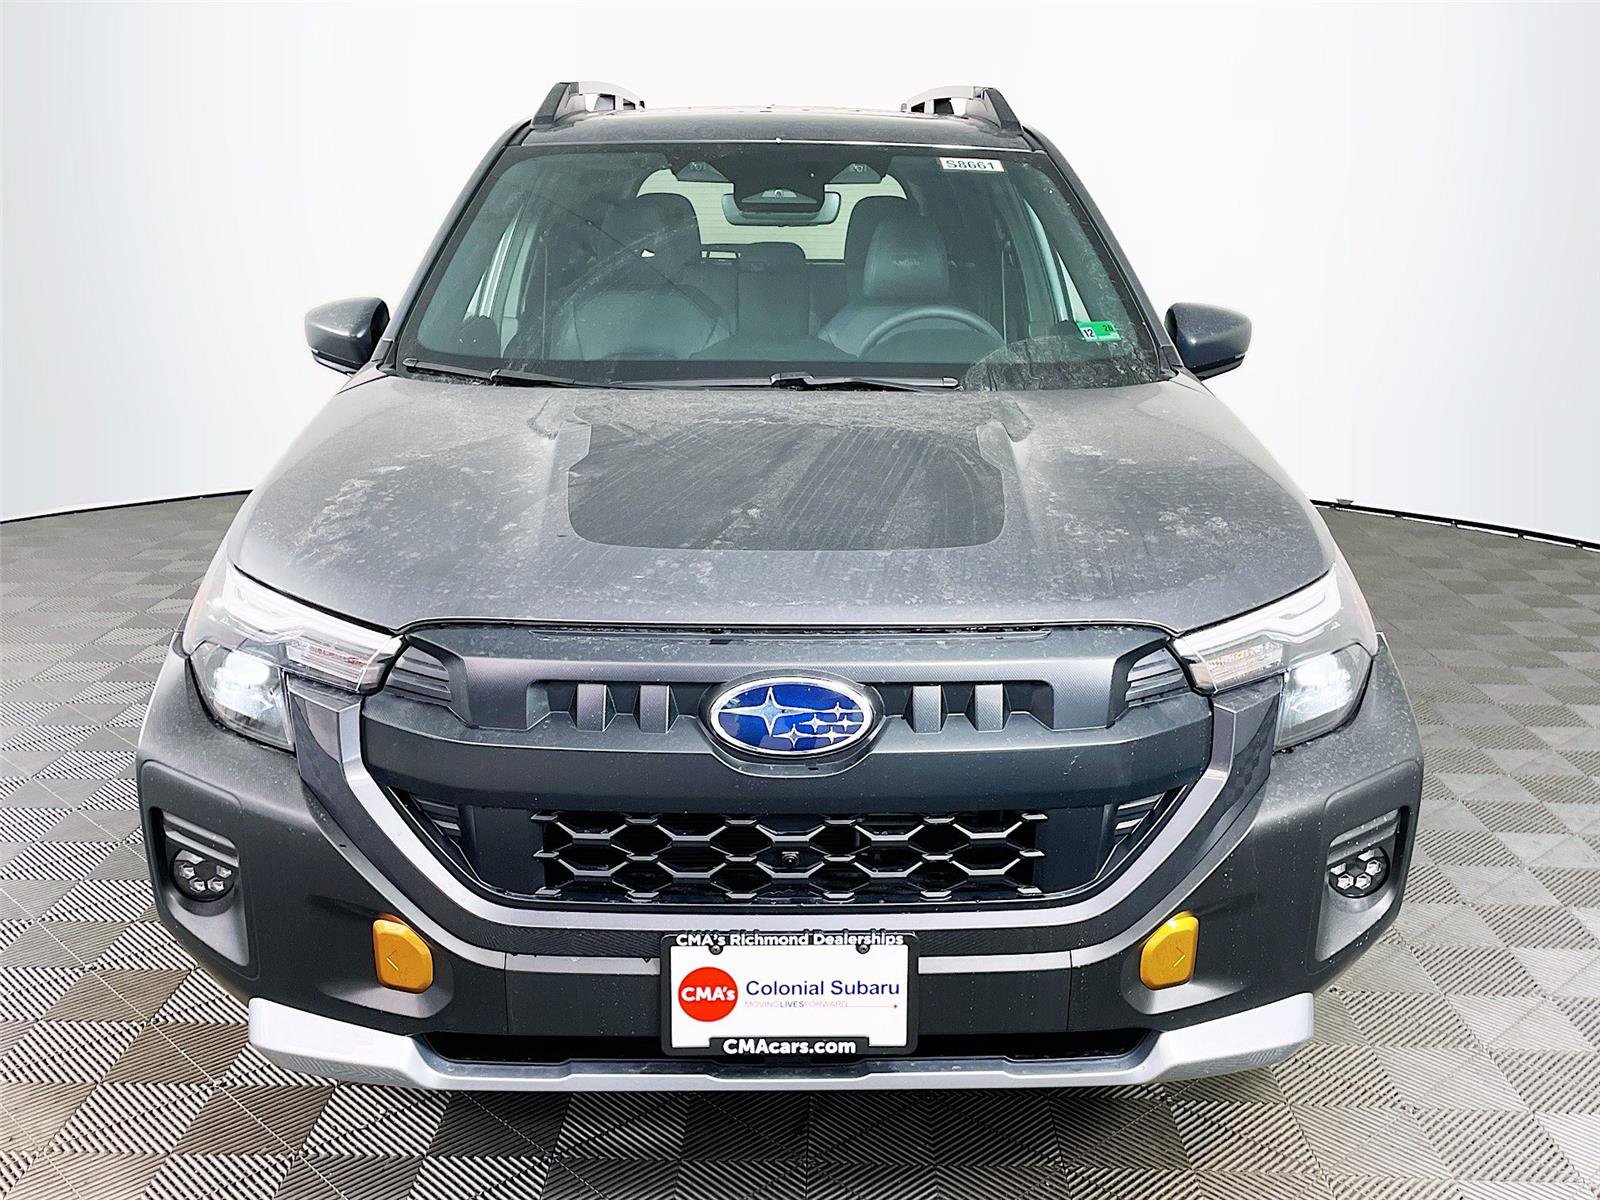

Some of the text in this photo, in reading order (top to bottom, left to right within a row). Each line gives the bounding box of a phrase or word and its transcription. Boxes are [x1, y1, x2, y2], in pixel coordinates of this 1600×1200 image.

[946, 159, 995, 170] S8661
[1083, 328, 1095, 338] 12
[676, 932, 904, 947] CMA's Richmond Dealerships
[681, 986, 736, 1002] CMA's
[745, 980, 900, 996] Colonial Subaru
[722, 1038, 857, 1055] CMAcars.com
